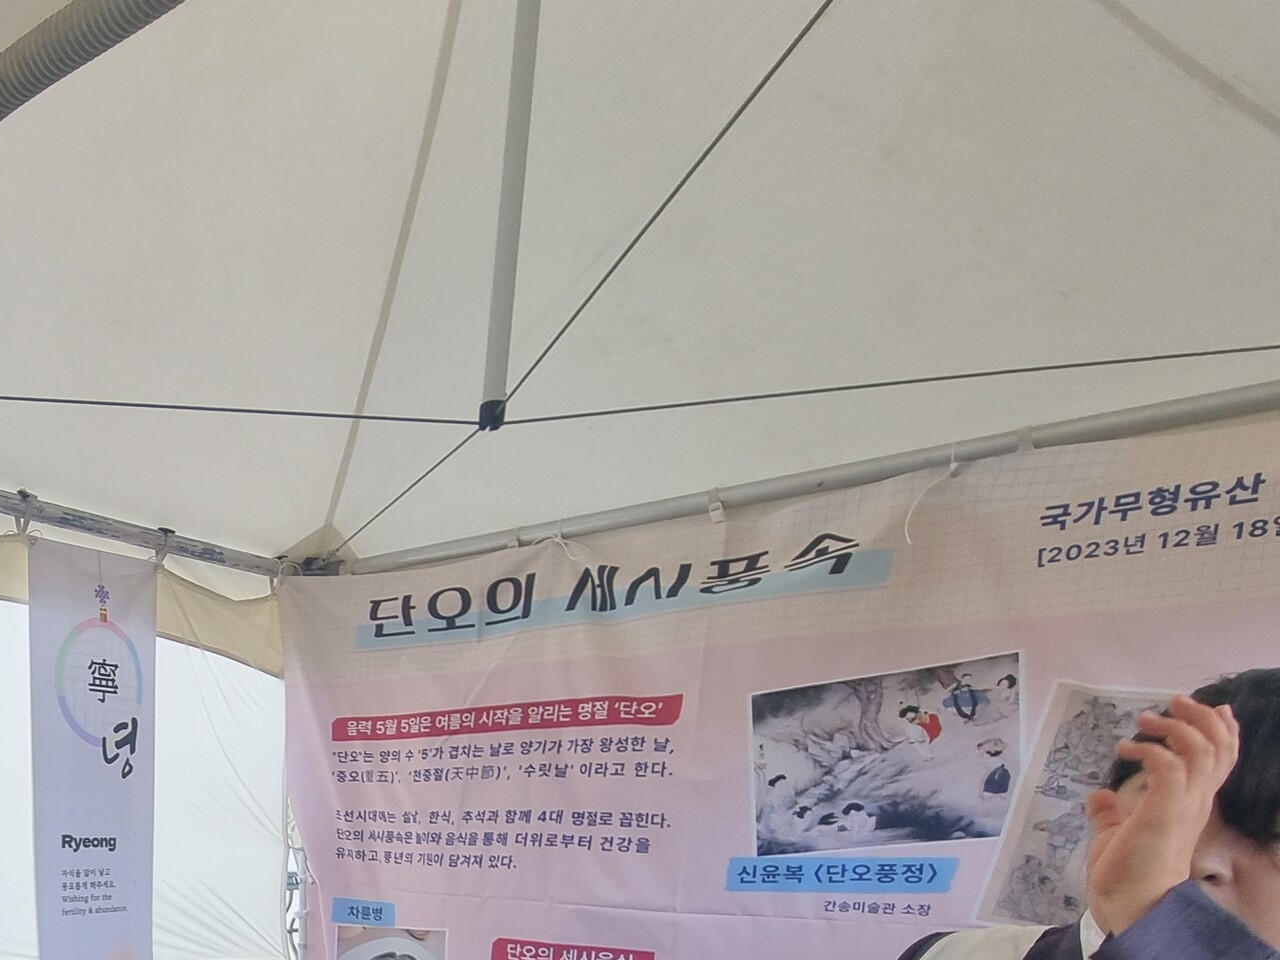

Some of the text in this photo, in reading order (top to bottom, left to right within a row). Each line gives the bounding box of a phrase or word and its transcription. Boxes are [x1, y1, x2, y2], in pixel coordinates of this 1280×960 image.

[1040, 473, 1266, 530] 국가무형유산
[1037, 516, 1280, 568] [2023년 12월 18
[369, 533, 860, 638] 단오의 세시풍속
[88, 659, 119, 703] 寧
[347, 718, 372, 736] 음력
[376, 718, 397, 735] 5월
[401, 716, 432, 733] 5일은
[436, 712, 475, 731] 여름의
[479, 708, 524, 727] 시작을
[528, 704, 573, 724] 알리는
[578, 701, 609, 720] 명절
[103, 717, 138, 778] 녕
[379, 749, 401, 763] 양의
[405, 750, 415, 762] 수
[448, 744, 484, 759] 겹치는
[490, 742, 514, 757] 날로
[520, 739, 563, 755] 양기가
[567, 738, 594, 753] 가장
[599, 736, 646, 753] 왕성한
[654, 736, 674, 754] 날,
[579, 761, 625, 778] 이라고
[634, 761, 673, 777] 한다.
[429, 810, 455, 826] 한식,
[462, 809, 499, 824] 추석과
[505, 809, 532, 824] 함께
[537, 810, 564, 824] 4대
[571, 811, 613, 827] 명절로
[619, 812, 671, 828] 꼽힌다.
[61, 834, 117, 853] Ryeong
[336, 828, 364, 842] 단오의
[445, 832, 478, 846] 음식을
[482, 831, 508, 846] 통해
[515, 833, 593, 851] 더위로부터
[600, 836, 651, 854] 건강을
[384, 850, 414, 865] 풍년의
[417, 851, 444, 867] 기원이
[449, 853, 483, 868] 담겨져
[488, 854, 517, 869] 있다.
[737, 864, 805, 884] 신윤복
[347, 904, 383, 922] 차륜병
[824, 900, 932, 917] 간송미술관 소장
